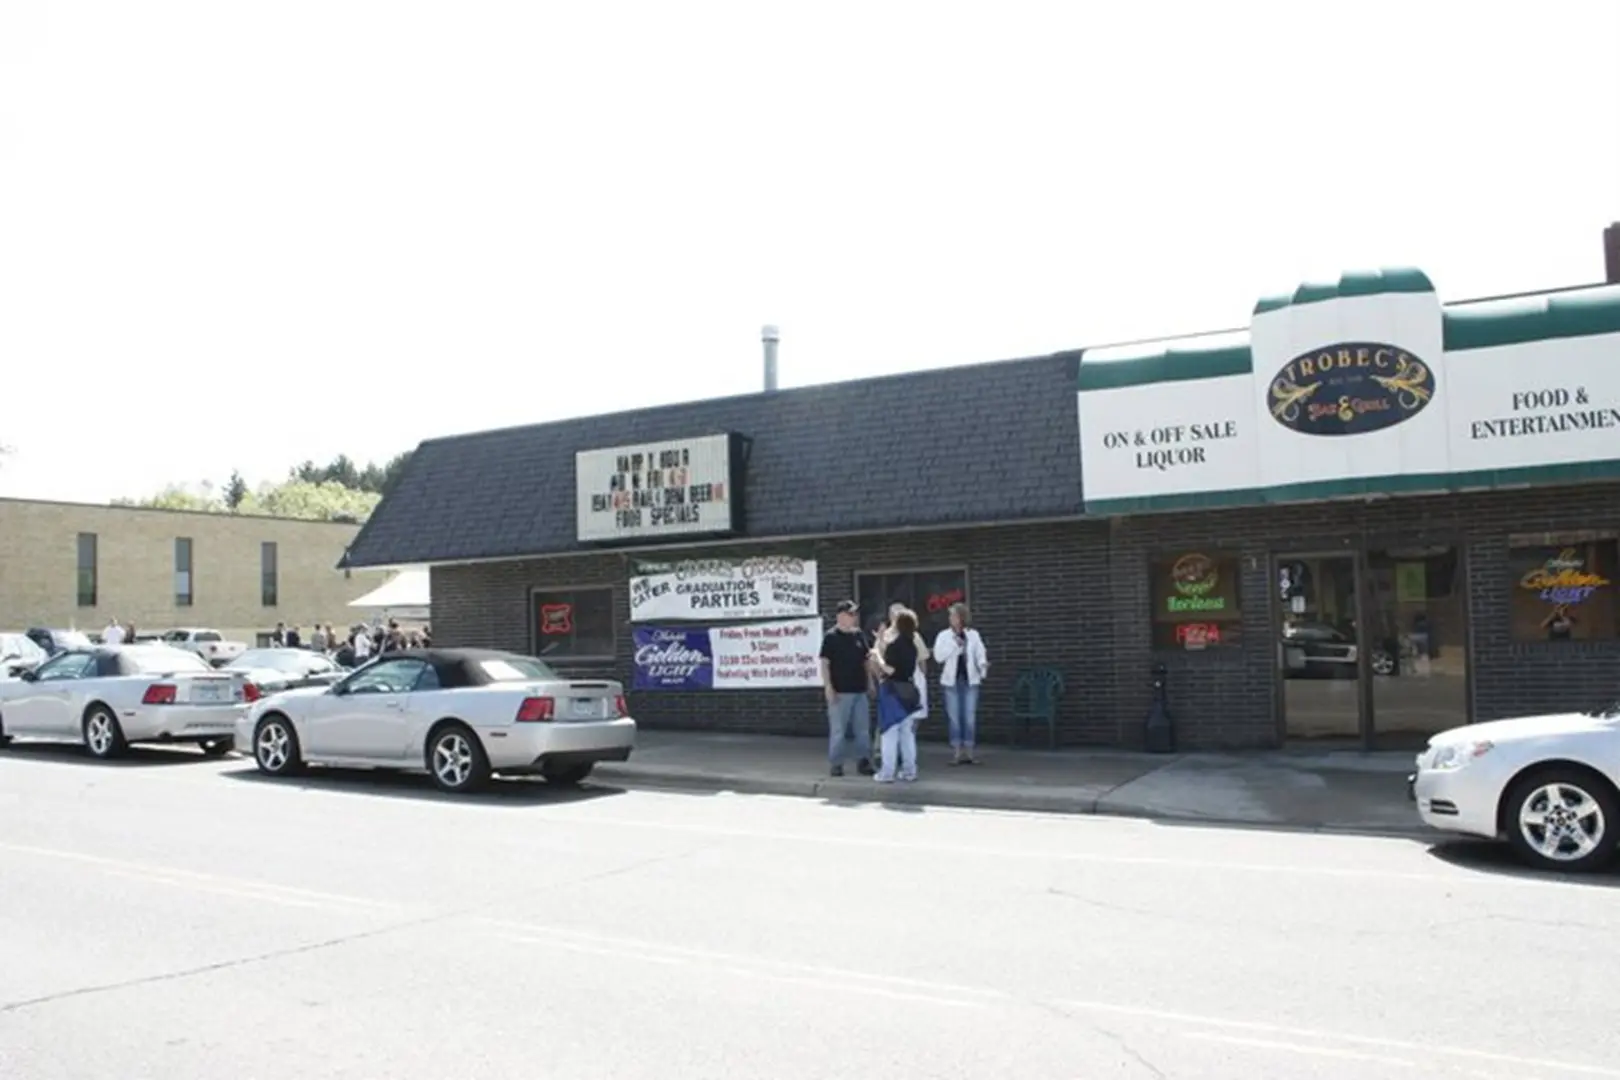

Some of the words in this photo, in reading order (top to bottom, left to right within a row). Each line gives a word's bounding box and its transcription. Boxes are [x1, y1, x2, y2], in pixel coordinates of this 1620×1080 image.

[1285, 348, 1410, 381] TROBEC'S
[1512, 388, 1568, 411] FOOD
[1576, 386, 1589, 404] &
[1103, 430, 1129, 449] ON
[1134, 429, 1146, 447] &
[1150, 426, 1185, 446] OFF
[1190, 421, 1237, 441] SALE
[1136, 447, 1206, 470] LIQUOR
[651, 503, 699, 525] SPECIALS
[632, 581, 671, 608] CATER
[676, 579, 756, 595] GRADUATION
[691, 591, 760, 609] PARTIES
[649, 664, 700, 678] LIGHT
